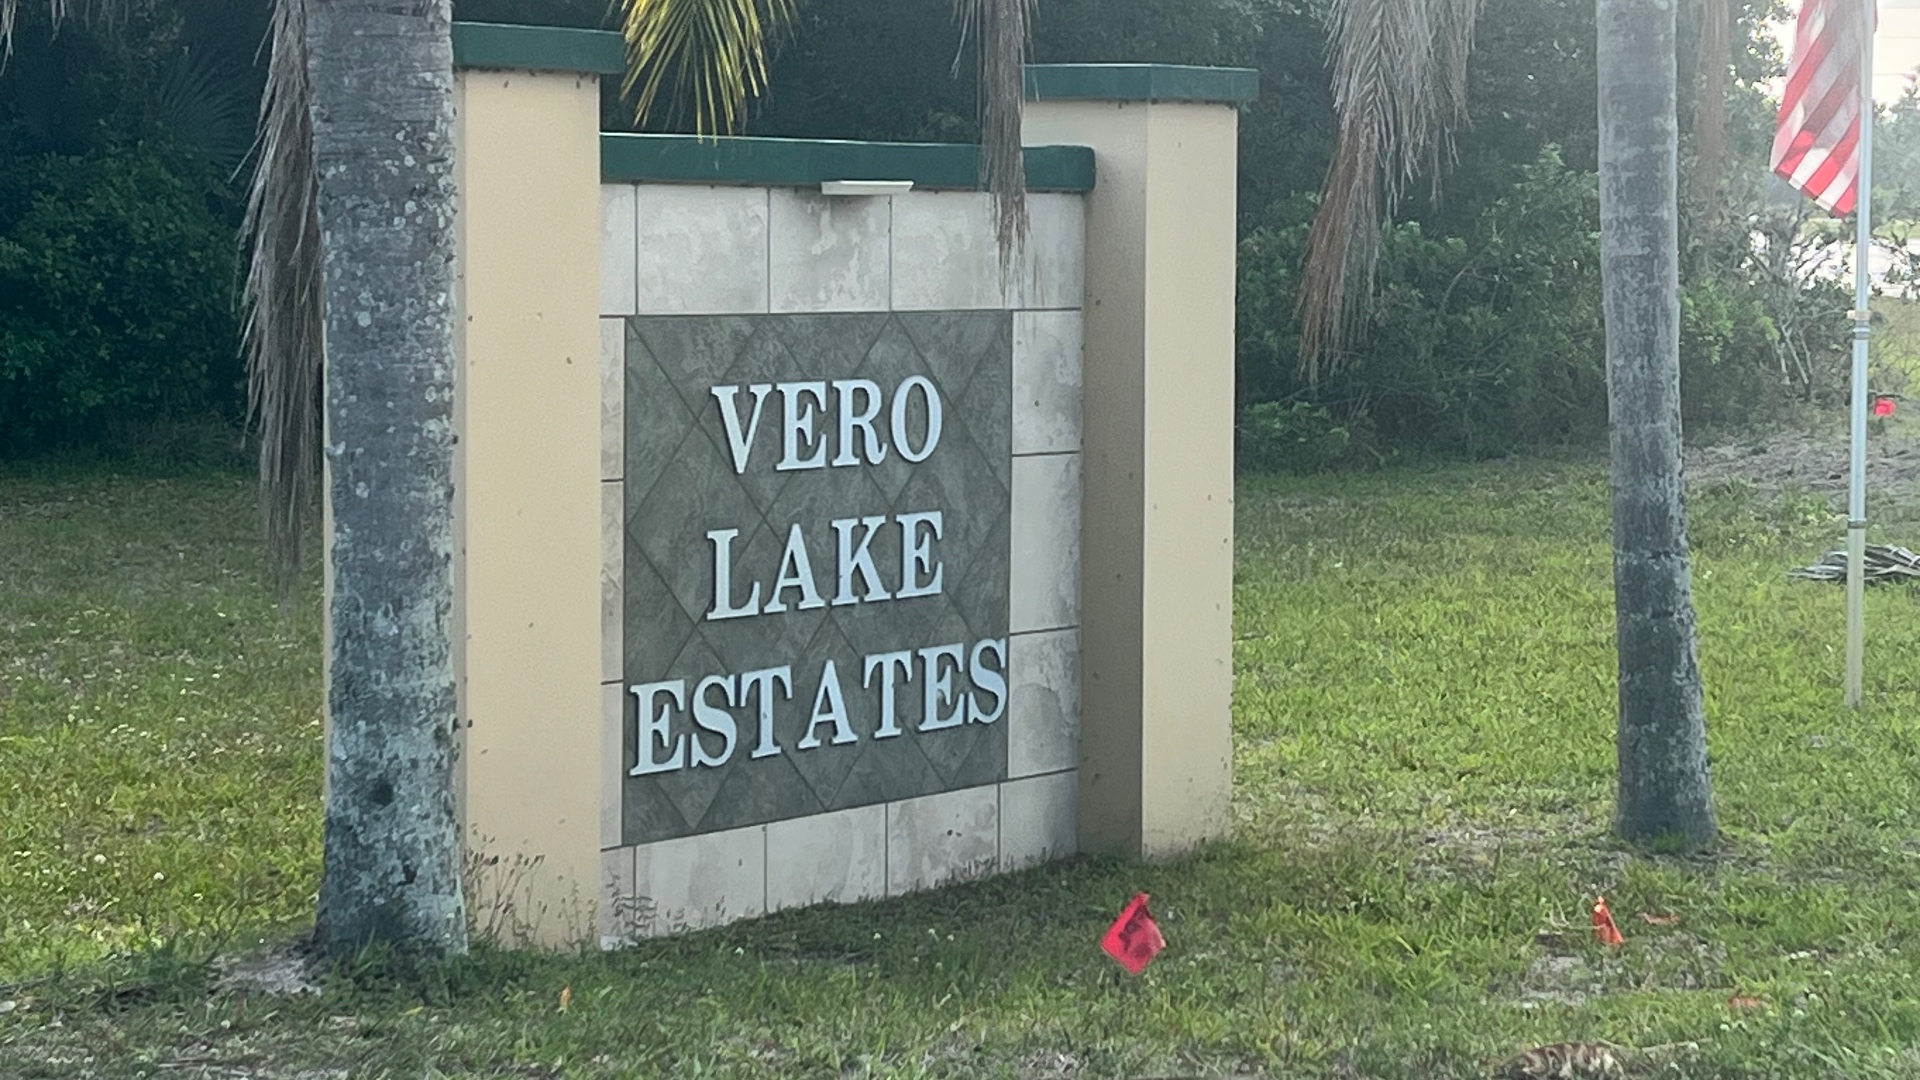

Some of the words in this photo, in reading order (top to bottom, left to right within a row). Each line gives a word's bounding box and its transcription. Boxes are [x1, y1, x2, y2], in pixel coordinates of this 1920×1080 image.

[711, 375, 943, 474] VERO
[706, 511, 943, 620] LAKE
[629, 638, 1008, 776] ESTATES
